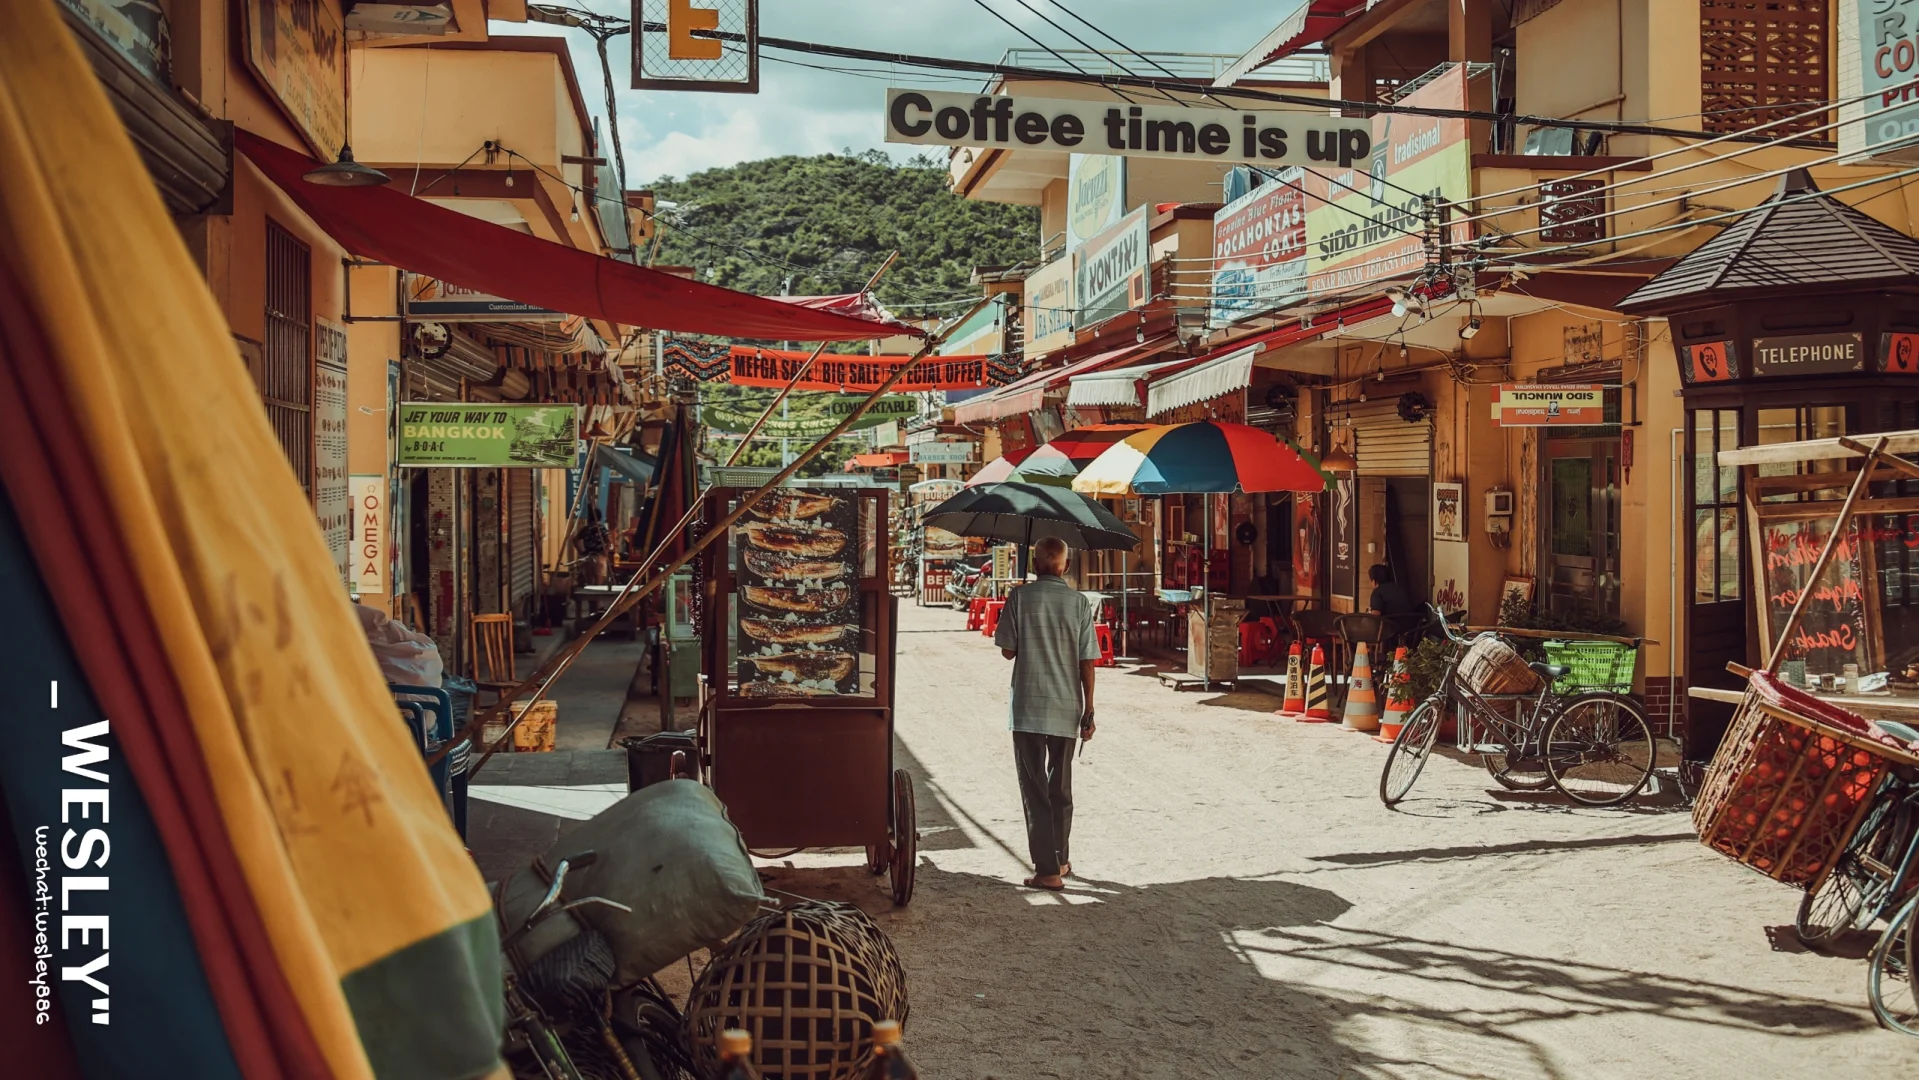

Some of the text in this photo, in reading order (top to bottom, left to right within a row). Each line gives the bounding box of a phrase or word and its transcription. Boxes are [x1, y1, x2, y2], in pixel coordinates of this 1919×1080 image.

[890, 93, 1371, 168] Coffee time is up
[1394, 120, 1441, 164] tradisional
[1247, 204, 1267, 222] Blue
[1217, 204, 1300, 259] POCAHONTAS
[1263, 231, 1302, 262] COAL
[1319, 223, 1358, 261] SIDO
[488, 303, 527, 311] Customized
[1760, 343, 1855, 364] TELEPHONE
[822, 362, 845, 383] BIG
[850, 362, 879, 384] SALE
[945, 361, 983, 383] OFFER
[1512, 392, 1594, 400] SIDO MUNCUL
[832, 400, 916, 415] COMORTABLE
[1566, 407, 1581, 415] jamu
[404, 411, 507, 424] JET YOUR WAY TO
[403, 425, 505, 439] BANGKOK
[925, 492, 957, 500] BURGE
[1437, 488, 1459, 501] COFFEE
[363, 495, 379, 576] OMEGA
[1437, 578, 1465, 613] coffee
